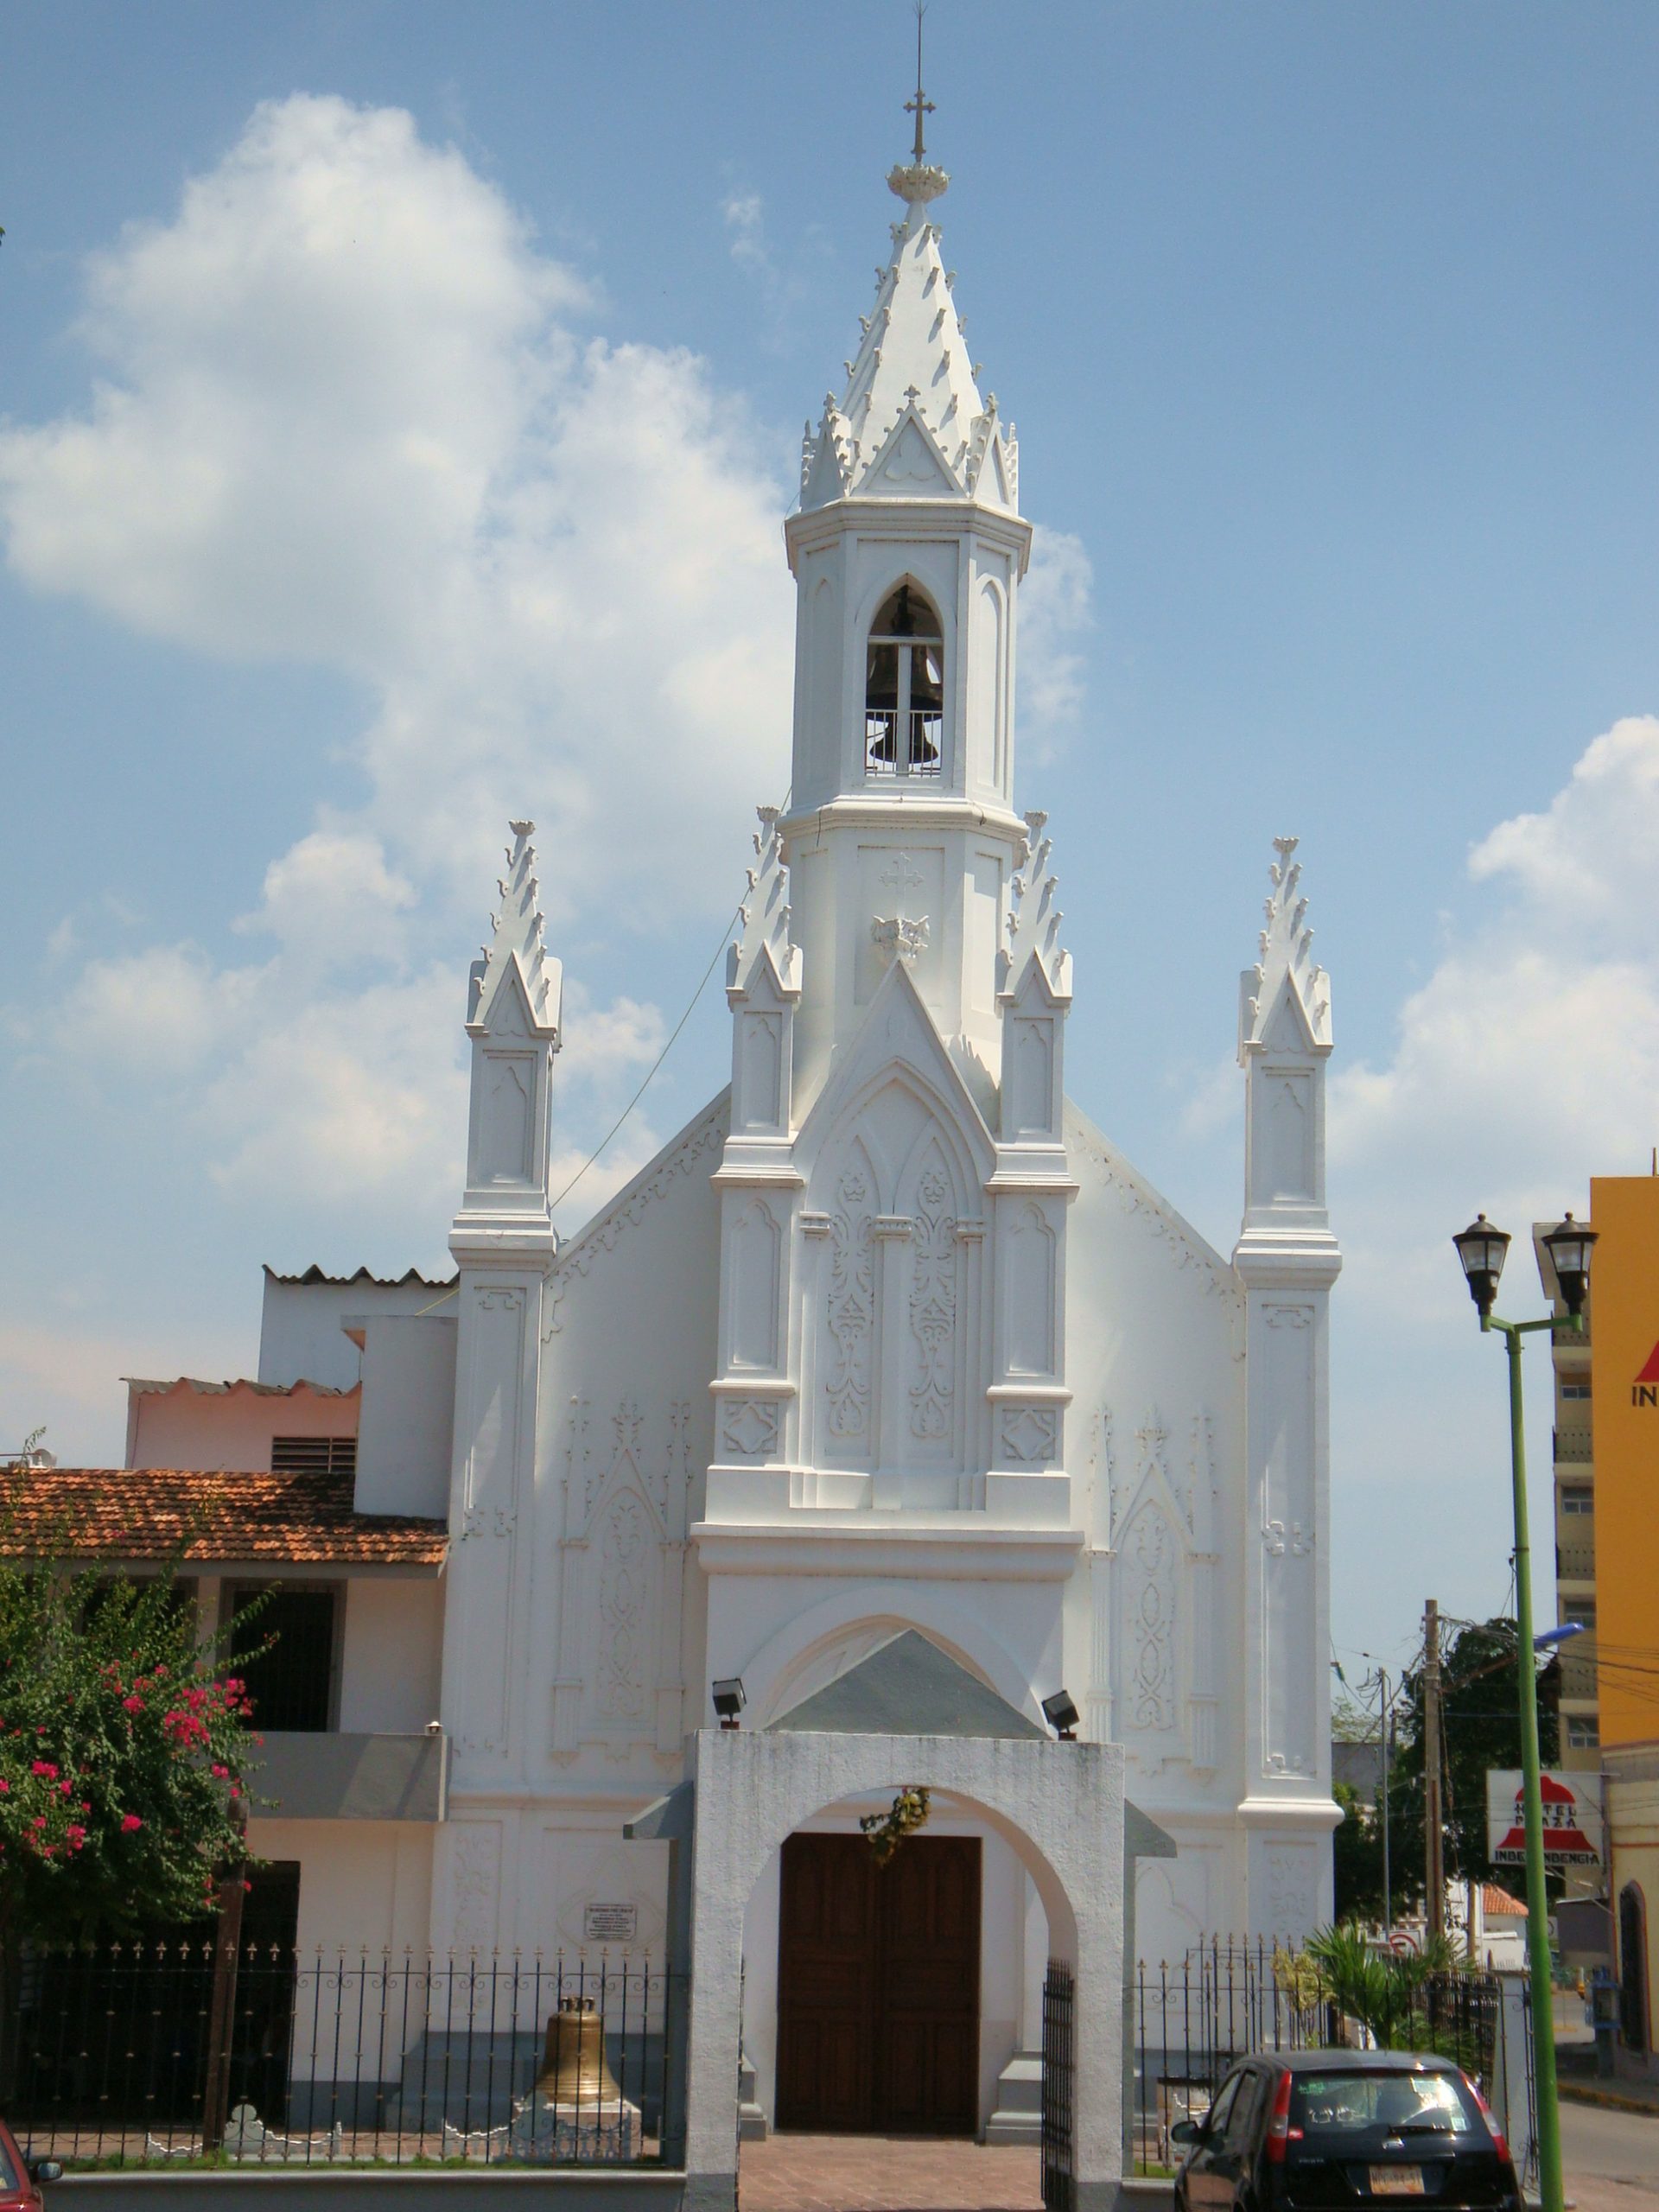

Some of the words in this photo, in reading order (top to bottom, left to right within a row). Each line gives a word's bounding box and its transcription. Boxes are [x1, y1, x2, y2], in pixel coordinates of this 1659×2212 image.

[1515, 1803, 1576, 1816] HTEL
[1516, 1815, 1577, 1828] PAZA
[1495, 1850, 1600, 1865] INDENDENCIA
